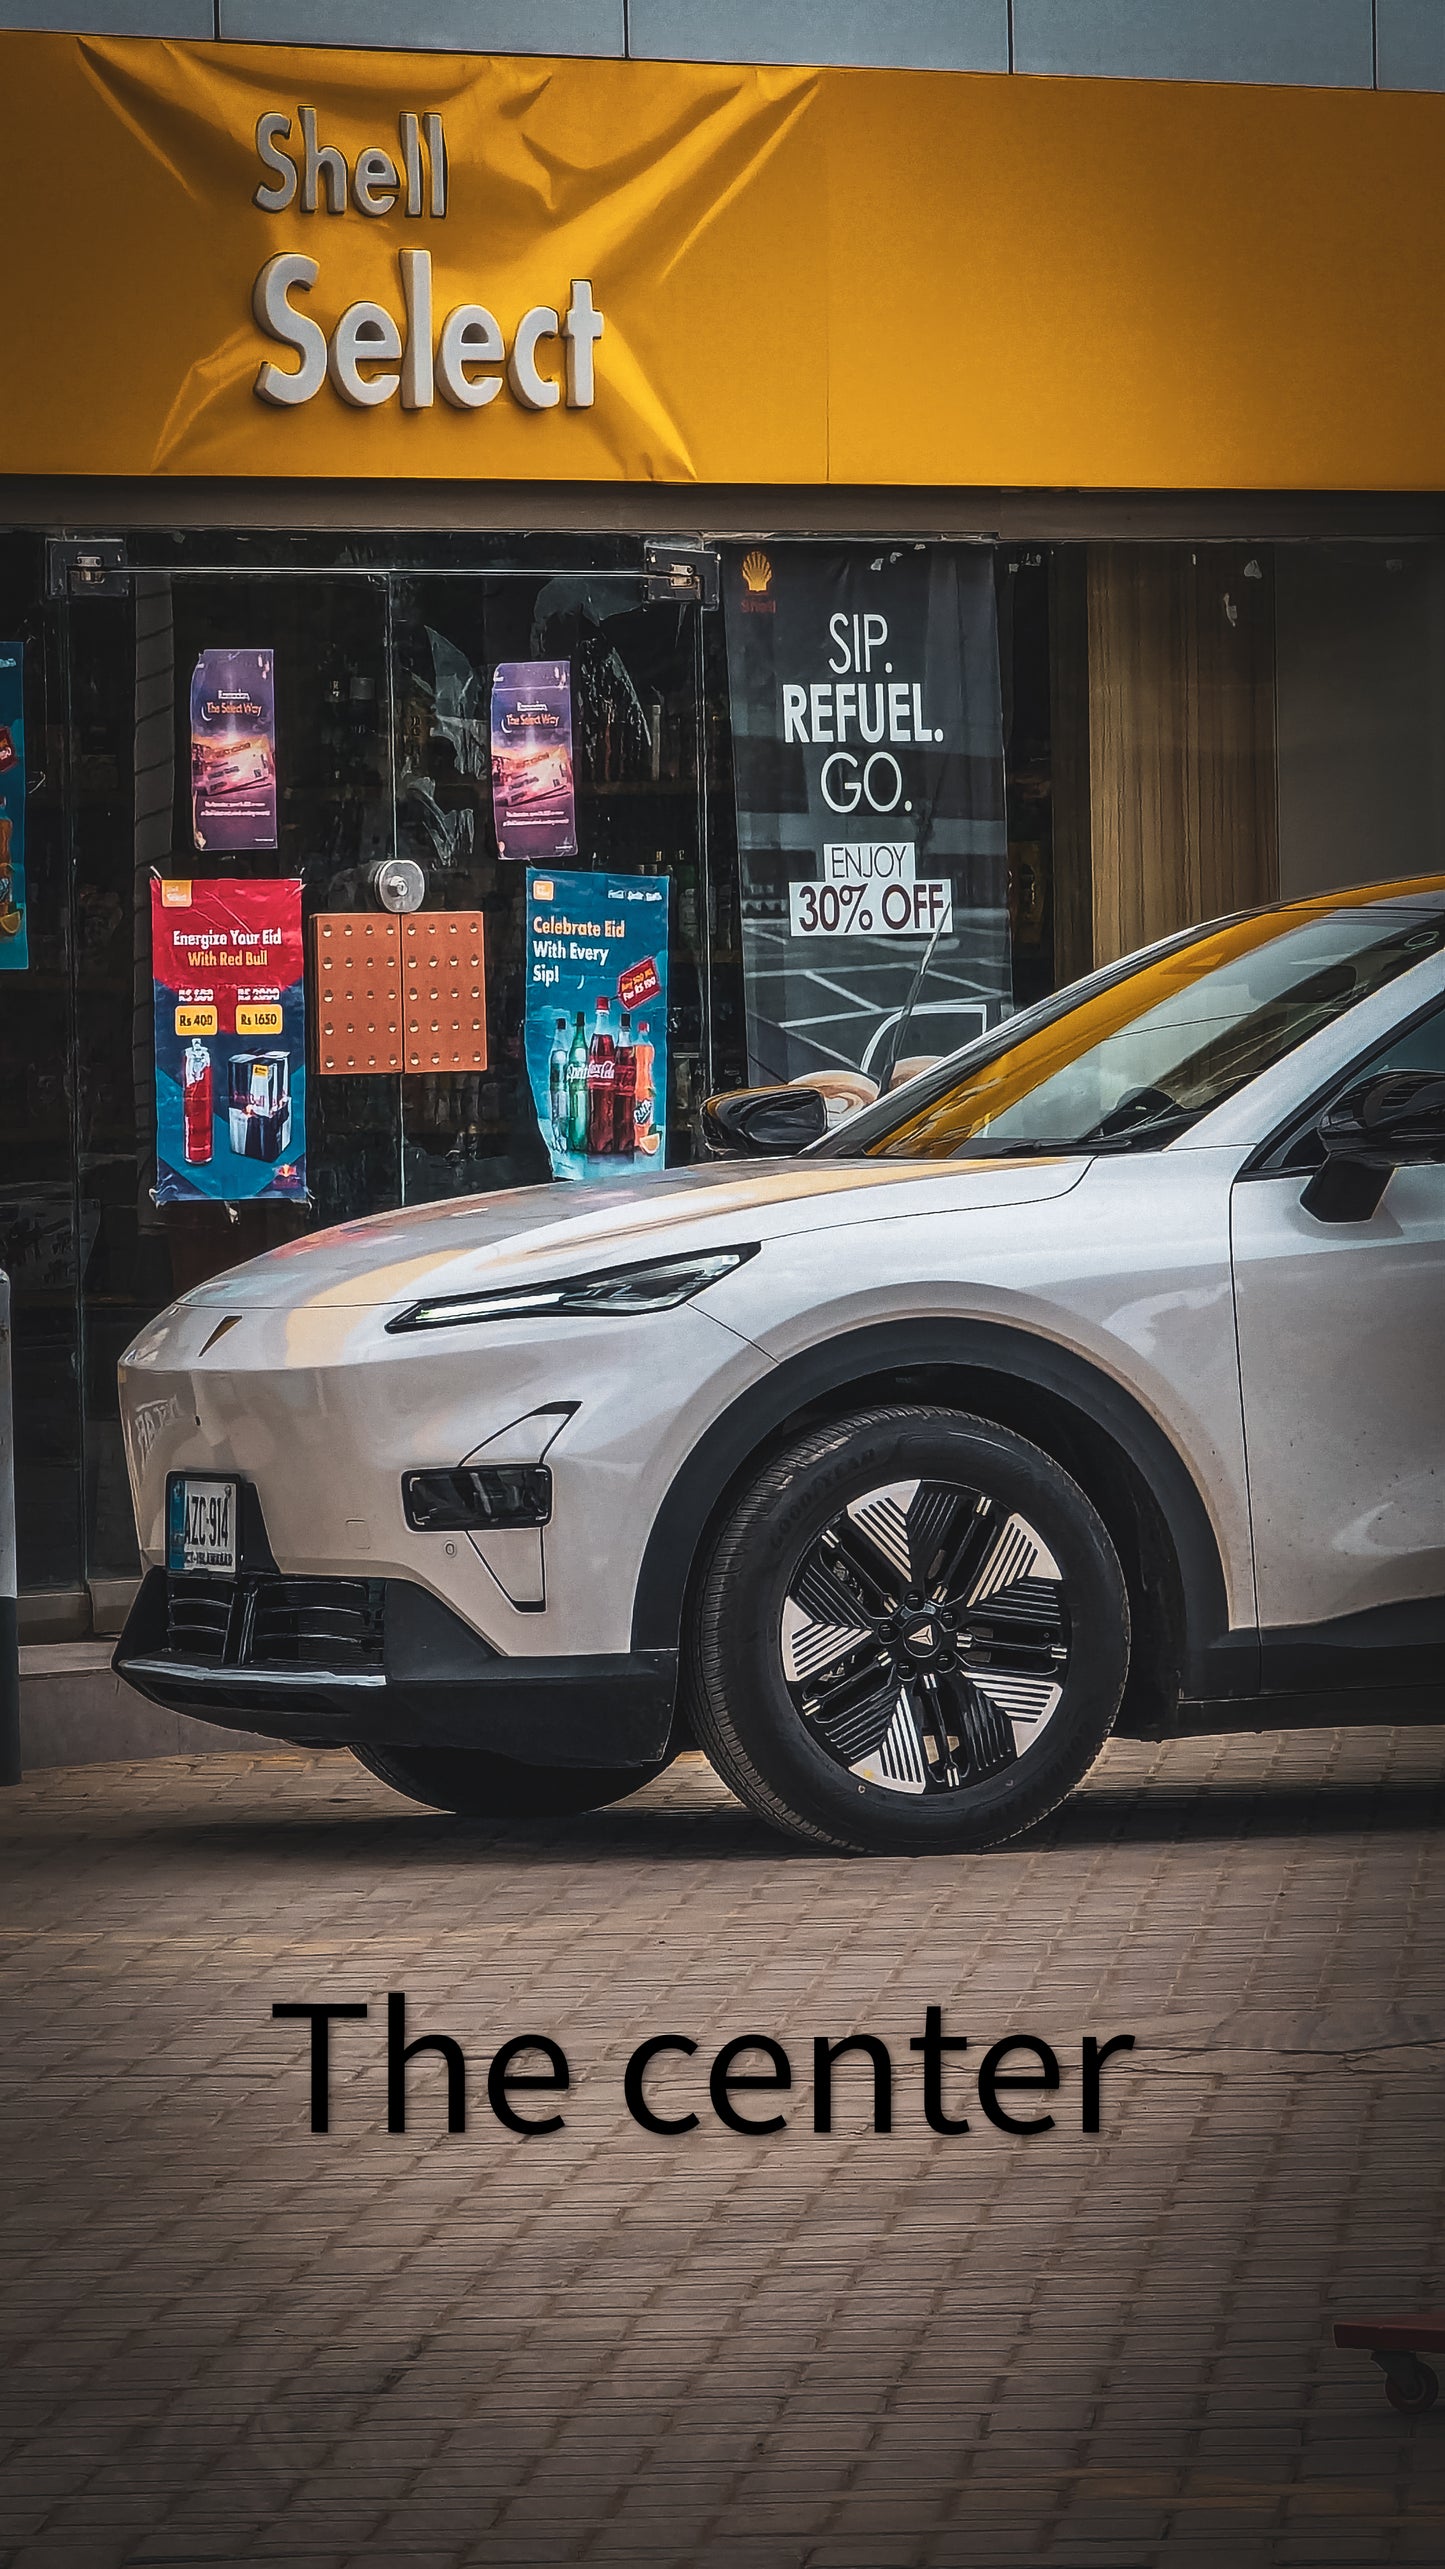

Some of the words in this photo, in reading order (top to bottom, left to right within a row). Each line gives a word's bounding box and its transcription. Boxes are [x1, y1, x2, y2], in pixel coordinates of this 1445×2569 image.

[254, 104, 449, 219] Shell
[252, 247, 604, 410] Select
[828, 612, 893, 674] SIP.
[782, 682, 944, 744] REFUEL.
[820, 751, 913, 814] GO.
[831, 845, 906, 878] ENJOY
[799, 882, 873, 934] 30%
[881, 882, 944, 931] OFF
[173, 929, 227, 949] Energize
[230, 929, 260, 945] Your
[262, 927, 282, 945] Eid
[533, 916, 601, 937] Celebrate
[604, 919, 625, 938] Eid
[187, 951, 217, 967] With
[219, 950, 243, 966] Red
[245, 950, 268, 966] Bull
[532, 940, 566, 959] With
[569, 942, 609, 966] Every
[179, 1015, 192, 1027] Rs
[193, 1014, 213, 1026] 400
[240, 1014, 252, 1025] Rs
[254, 1013, 277, 1025] 1650
